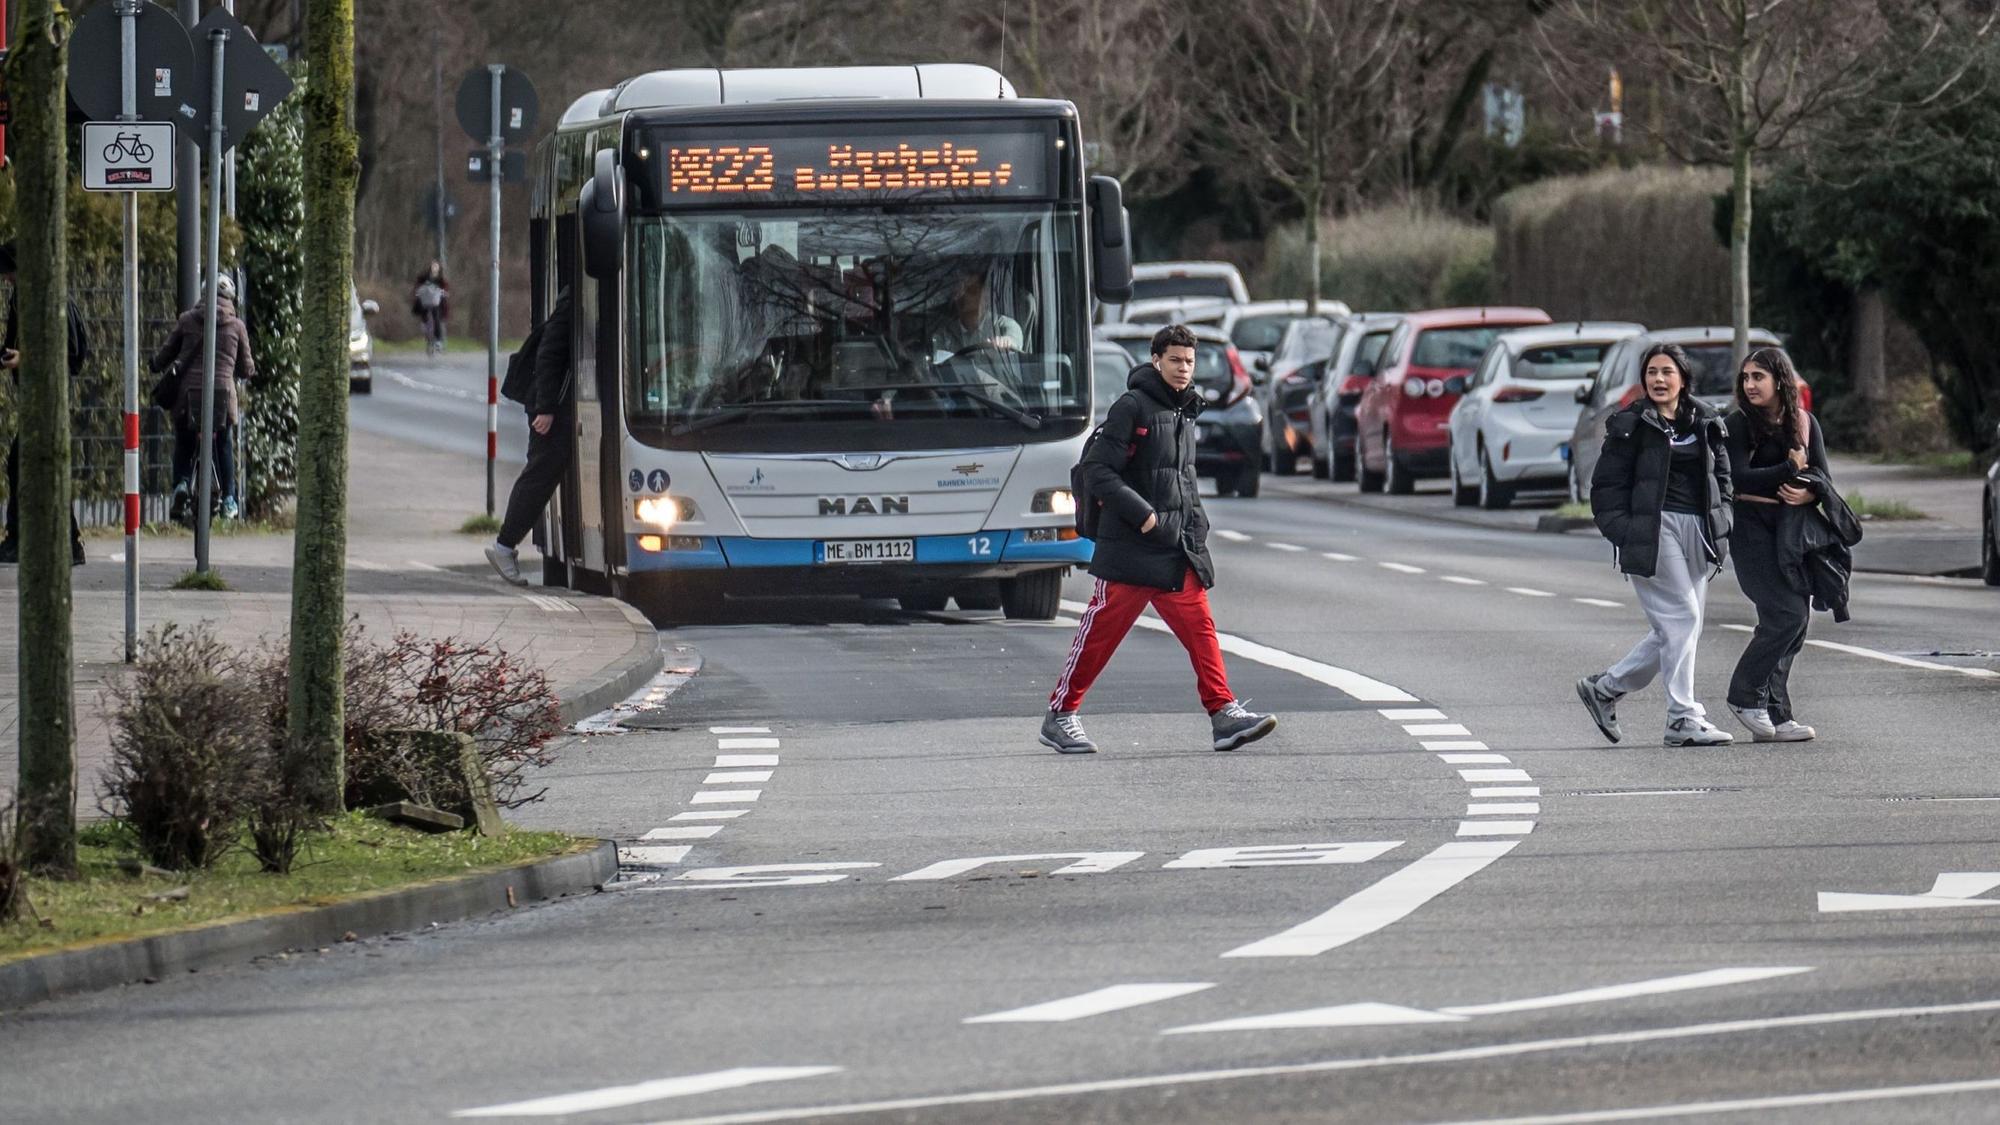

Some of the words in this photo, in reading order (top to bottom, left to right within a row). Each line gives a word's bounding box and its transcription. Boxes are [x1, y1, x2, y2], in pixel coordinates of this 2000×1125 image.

[817, 495, 909, 516] MAN
[827, 543, 845, 559] ME
[854, 543, 873, 559] BM
[876, 542, 911, 559] 1112
[967, 537, 991, 555] 12
